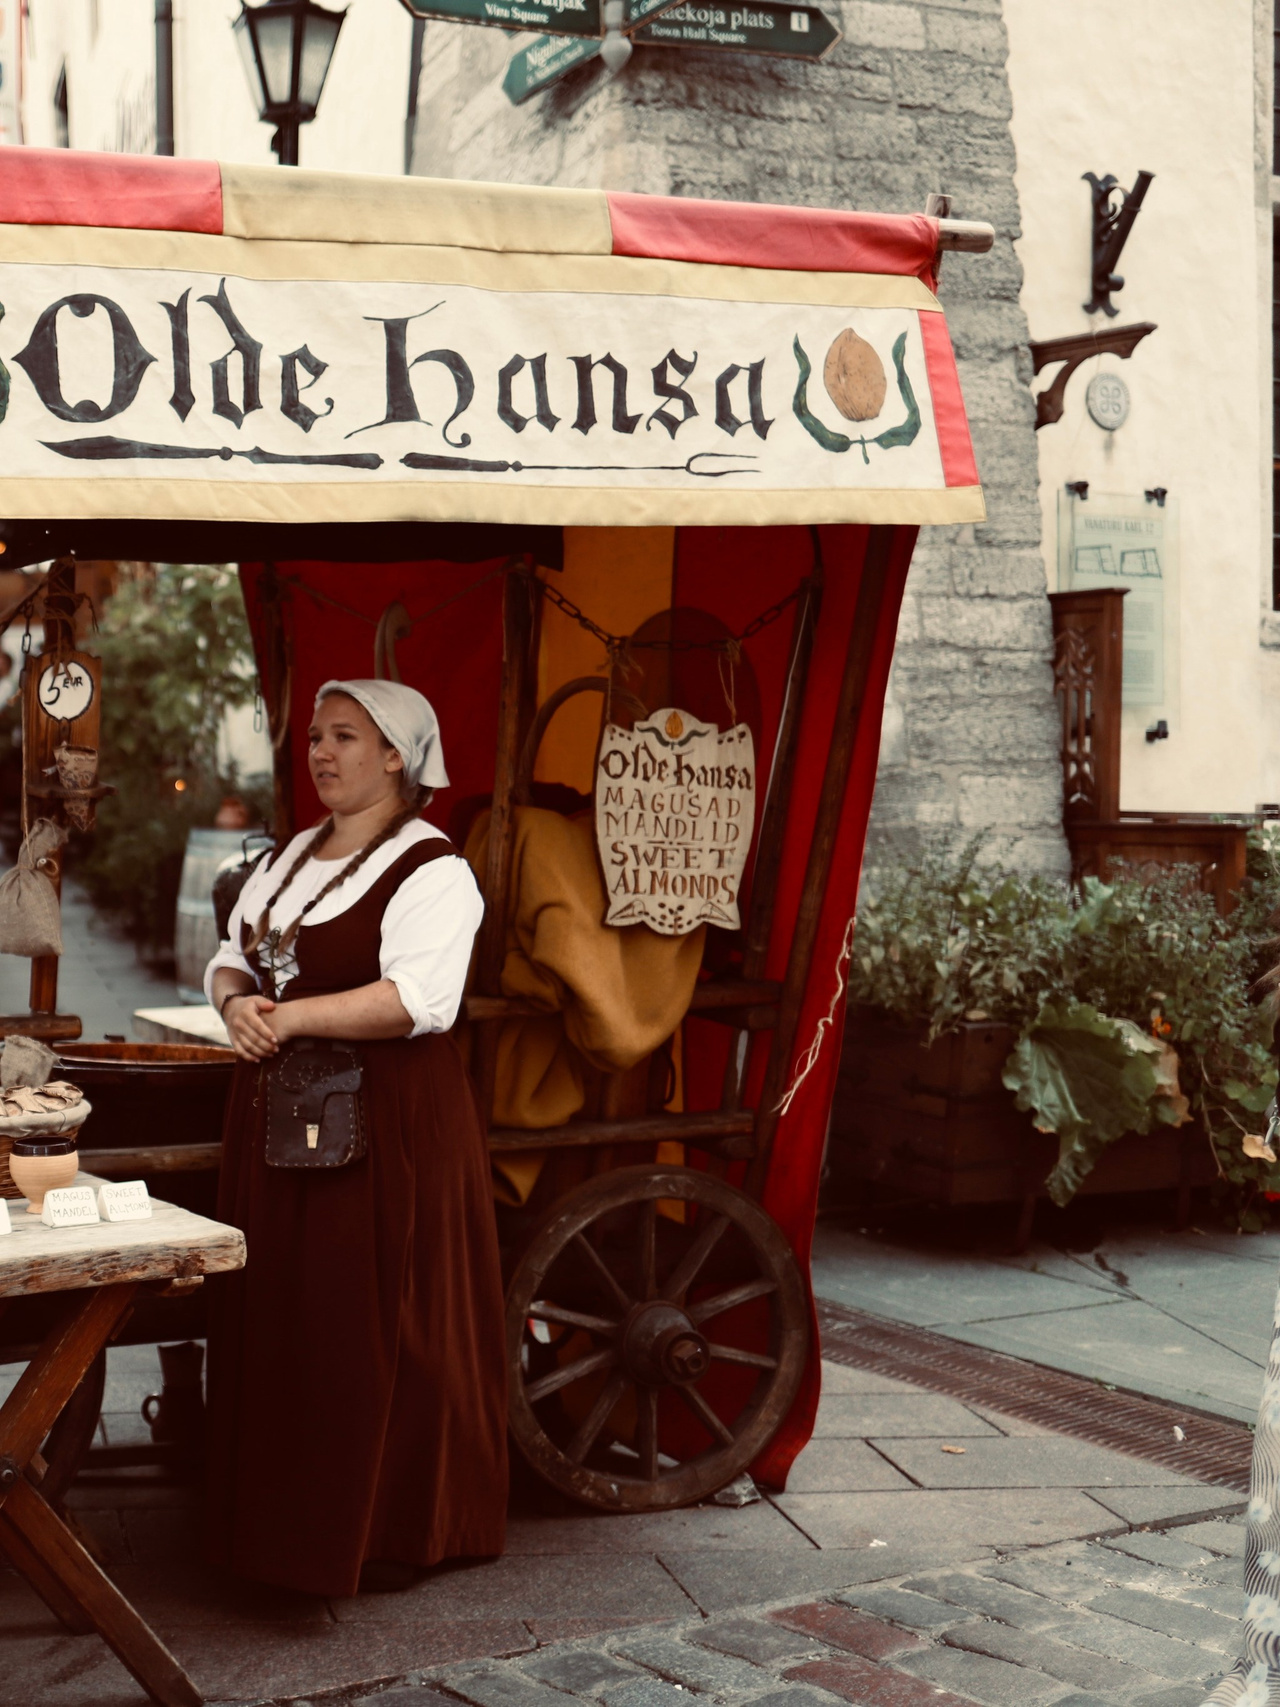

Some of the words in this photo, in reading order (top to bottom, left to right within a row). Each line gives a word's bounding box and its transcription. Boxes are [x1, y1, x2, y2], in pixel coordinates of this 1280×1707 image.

[485, 3, 510, 18] Viru
[511, 6, 549, 24] Square
[660, 2, 726, 28] aekoja
[730, 7, 775, 30] plats
[650, 23, 681, 38] Town
[682, 26, 707, 40] Hall
[708, 28, 747, 44] Square
[11, 277, 335, 433] Olde
[43, 671, 66, 706] 5
[62, 675, 84, 689] EUR
[599, 741, 669, 783] Olde
[603, 786, 741, 818] MAGUSAD
[604, 811, 740, 844] MANDLID
[610, 840, 737, 870] SWEET
[611, 866, 736, 905] ALMONDS
[51, 1191, 92, 1203] MAGUS
[105, 1187, 142, 1199] SWEET
[52, 1206, 97, 1218] MANDEL
